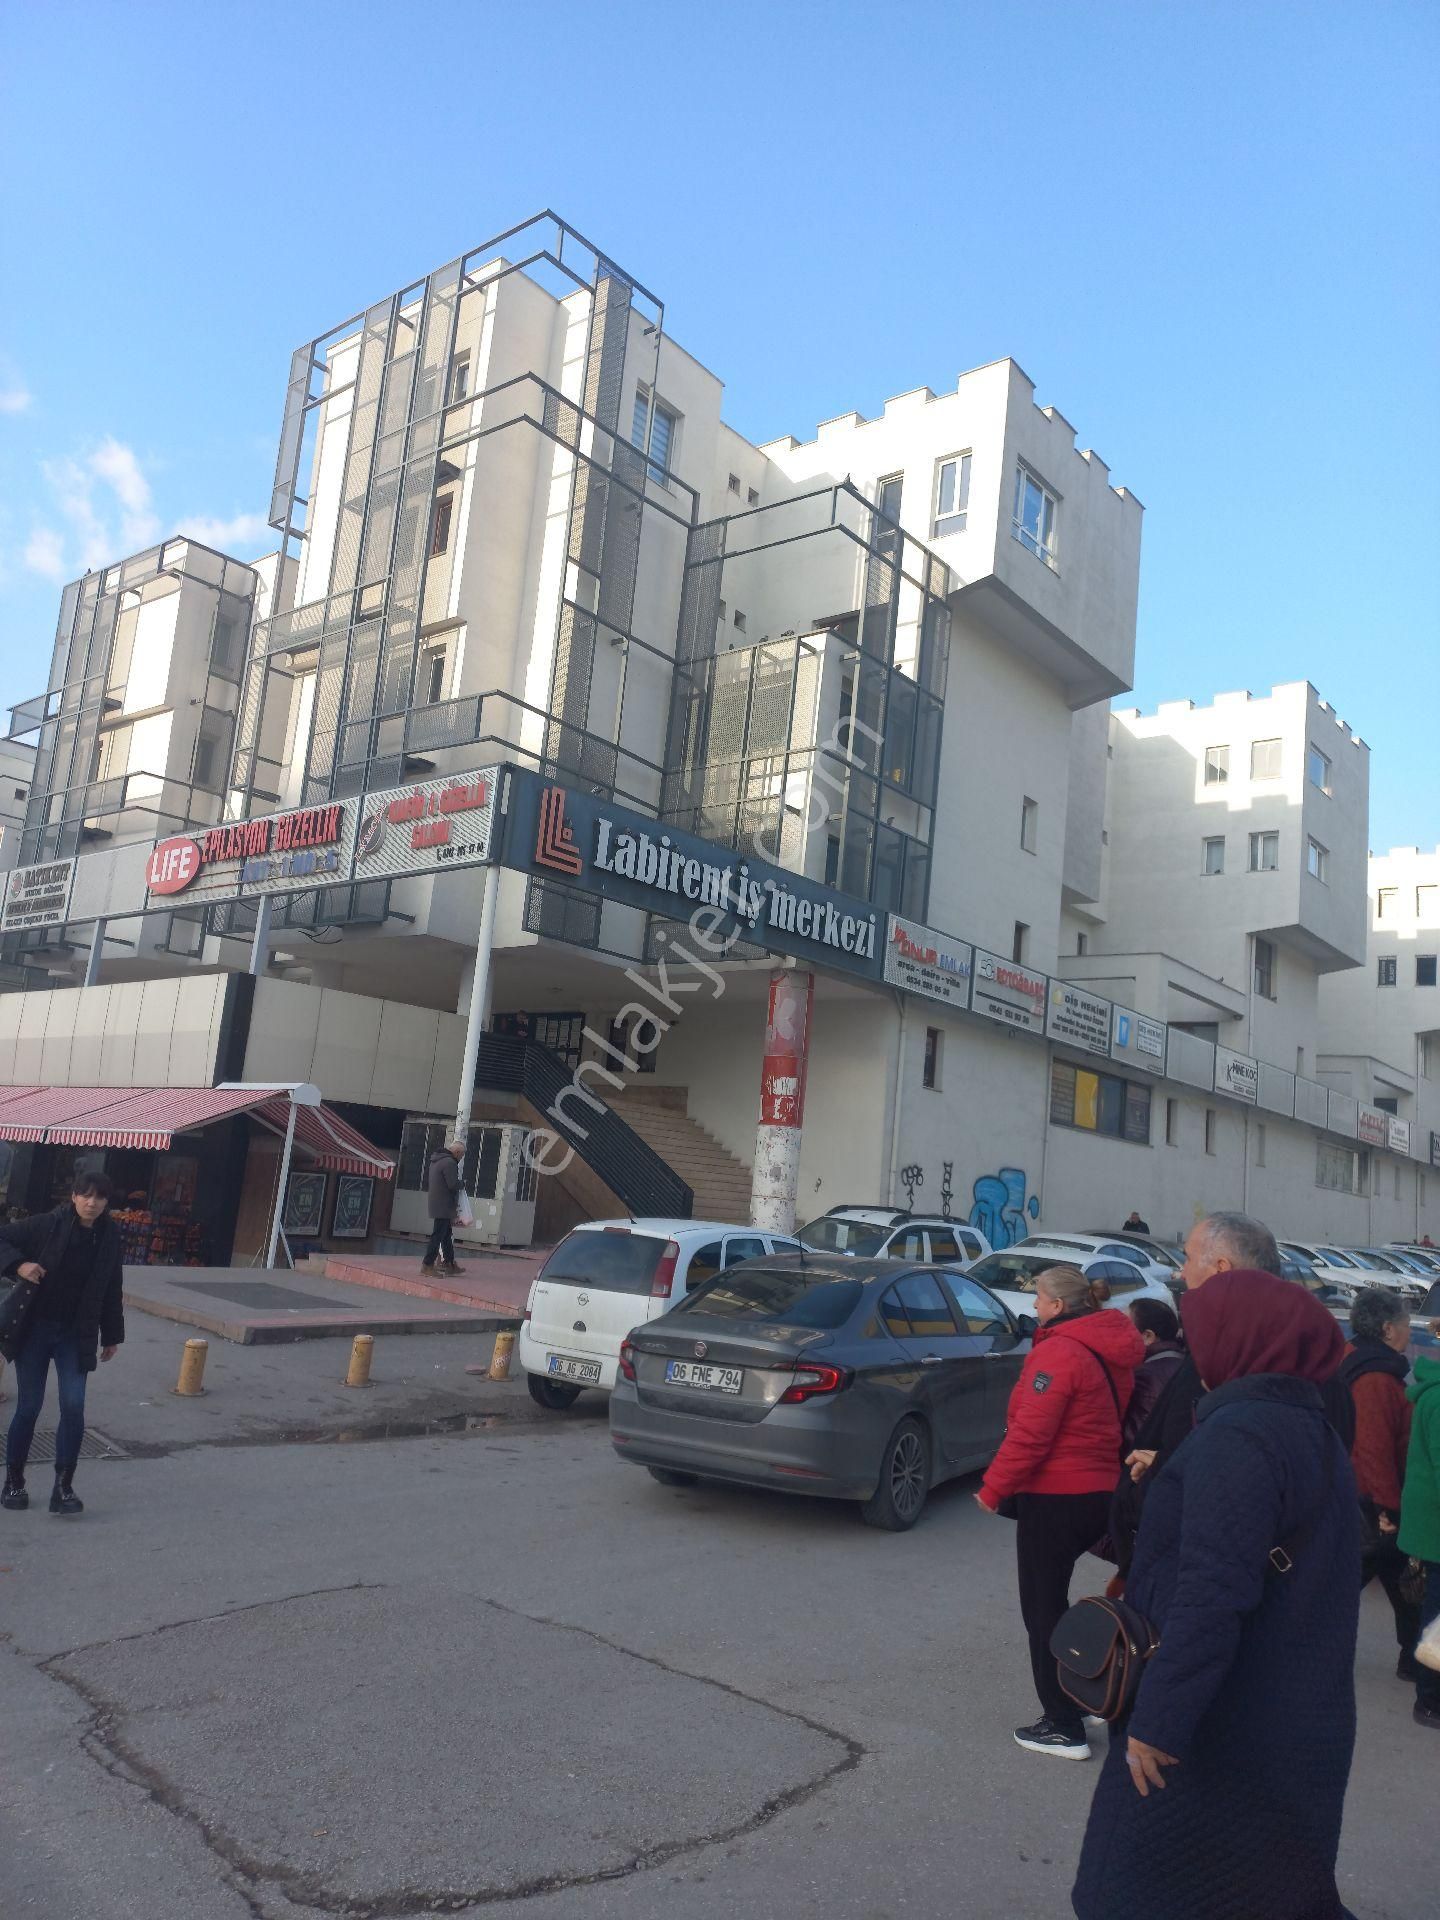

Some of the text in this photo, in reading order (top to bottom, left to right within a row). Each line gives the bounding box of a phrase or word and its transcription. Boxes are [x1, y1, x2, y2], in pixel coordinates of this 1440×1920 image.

[150, 845, 193, 884] LIFE
[593, 817, 877, 960] Labirent iş merkezi
[939, 953, 971, 978] EMLAK
[555, 1360, 564, 1372] 06
[673, 1364, 687, 1380] 06
[691, 1366, 713, 1384] FNE
[718, 1369, 740, 1388] 794
